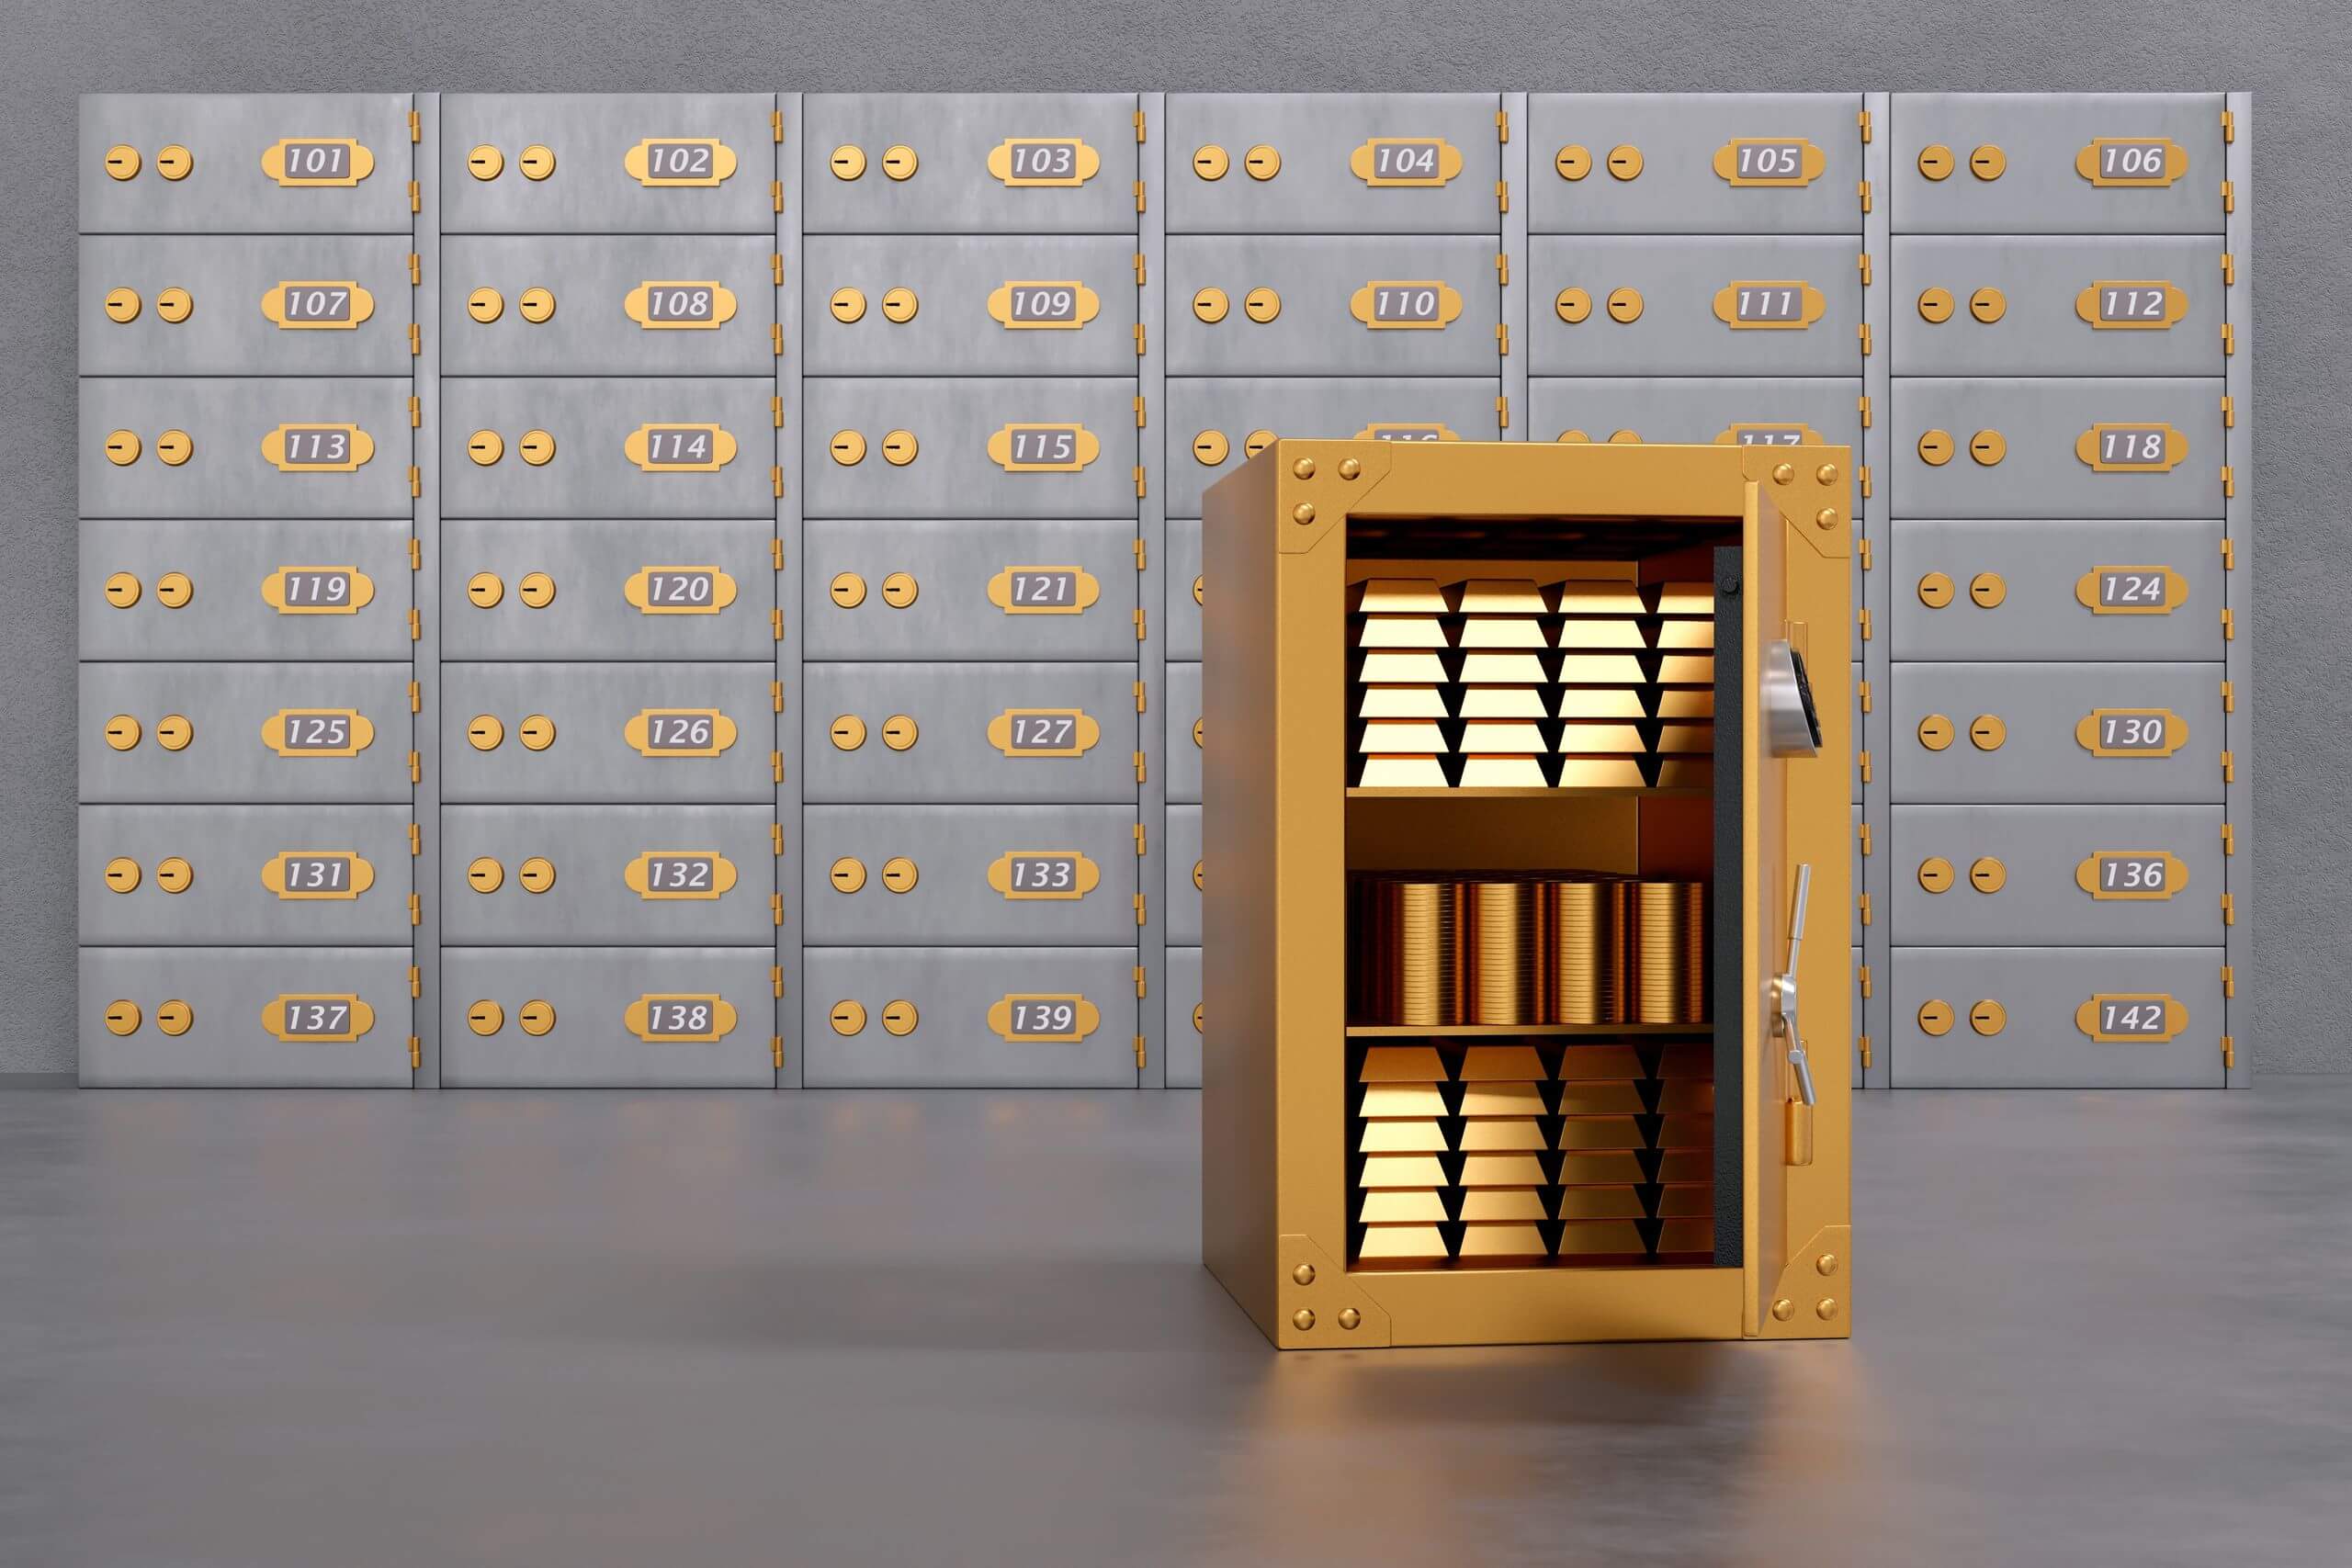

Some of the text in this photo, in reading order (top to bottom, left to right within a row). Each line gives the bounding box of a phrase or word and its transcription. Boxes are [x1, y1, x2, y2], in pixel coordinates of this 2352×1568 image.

[289, 148, 342, 173] 101
[652, 147, 709, 173] 102
[1014, 147, 1071, 173] 103
[1379, 147, 1434, 173] 104
[1740, 147, 1798, 173] 105
[2105, 148, 2163, 173] 106
[289, 290, 347, 316] 107
[652, 290, 708, 316] 108
[1013, 290, 1071, 316] 109
[1377, 290, 1435, 316] 110
[1739, 291, 1792, 316] 111
[2106, 290, 2163, 316] 112
[289, 434, 345, 459] 113
[650, 434, 706, 459] 114
[1015, 434, 1073, 459] 115
[2105, 434, 2162, 459] 118
[289, 576, 346, 602] 119
[652, 576, 709, 602] 120
[1014, 576, 1067, 601] 121
[2106, 576, 2160, 601] 124
[289, 719, 346, 744] 125
[652, 719, 710, 744] 126
[1015, 719, 1073, 744] 127
[2105, 719, 2162, 744] 130
[289, 862, 342, 887] 131
[652, 862, 708, 887] 132
[1014, 862, 1070, 887] 133
[2107, 862, 2164, 887] 136
[289, 1005, 347, 1031] 137
[651, 1005, 707, 1031] 138
[1015, 1005, 1072, 1031] 139
[2105, 1005, 2162, 1030] 142
